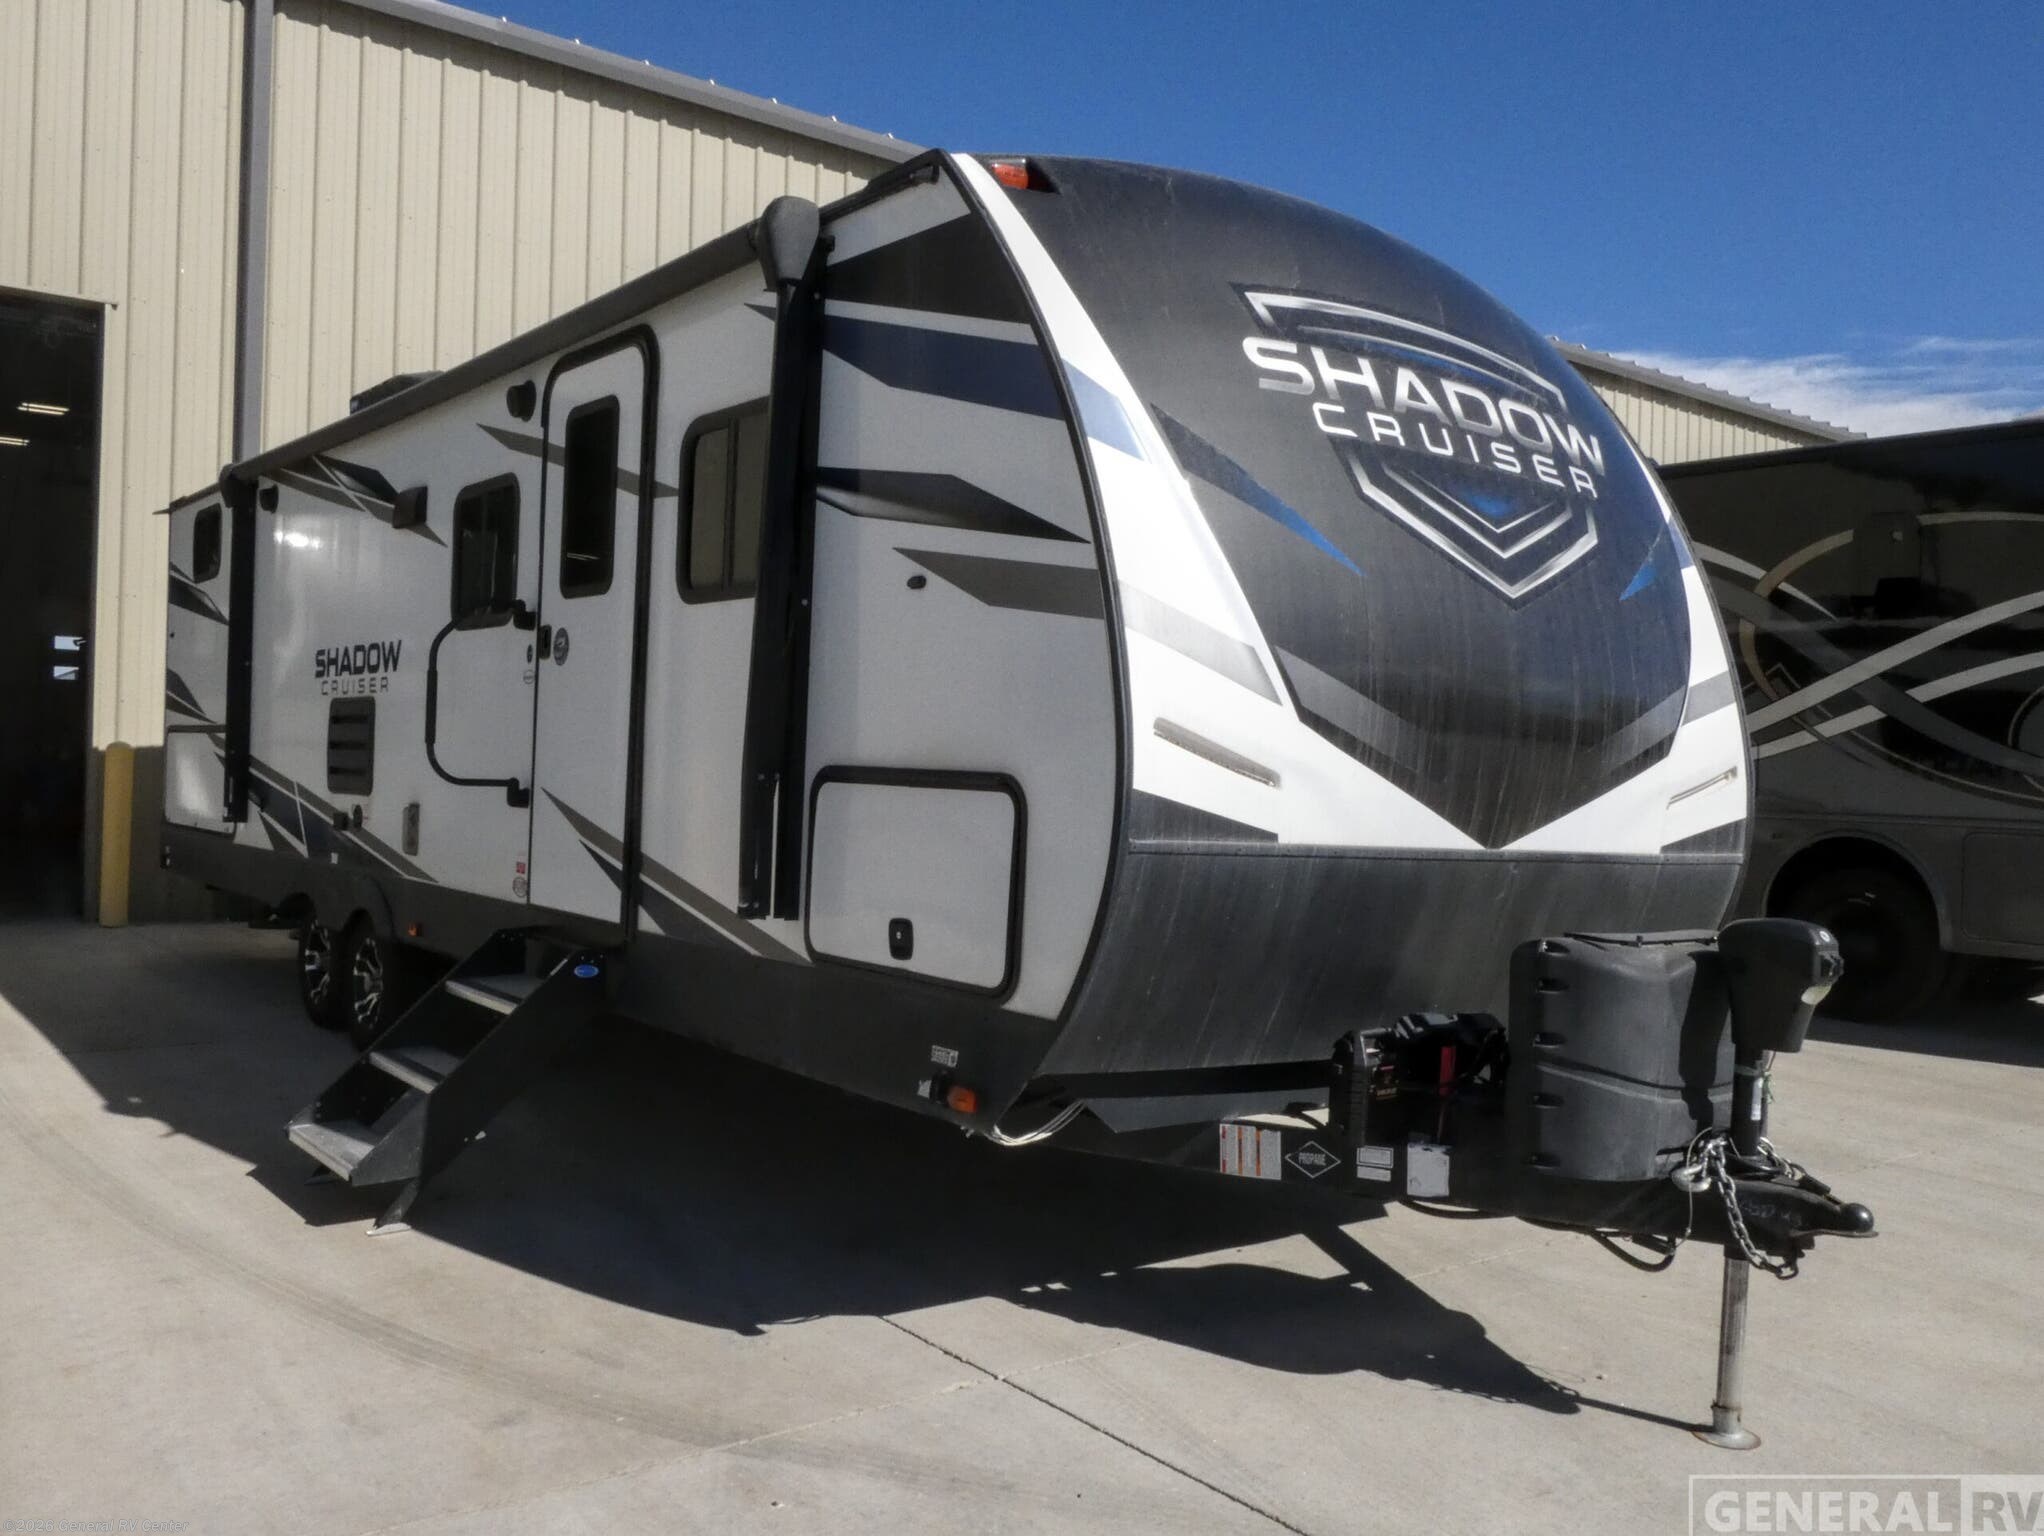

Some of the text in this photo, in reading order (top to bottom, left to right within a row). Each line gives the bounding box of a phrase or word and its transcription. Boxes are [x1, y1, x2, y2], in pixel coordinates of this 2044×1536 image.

[1242, 336, 1605, 477] SHADOW
[1312, 402, 1598, 498] CRUISER
[315, 639, 402, 679] SHADOW
[321, 676, 389, 696] CRUISER
